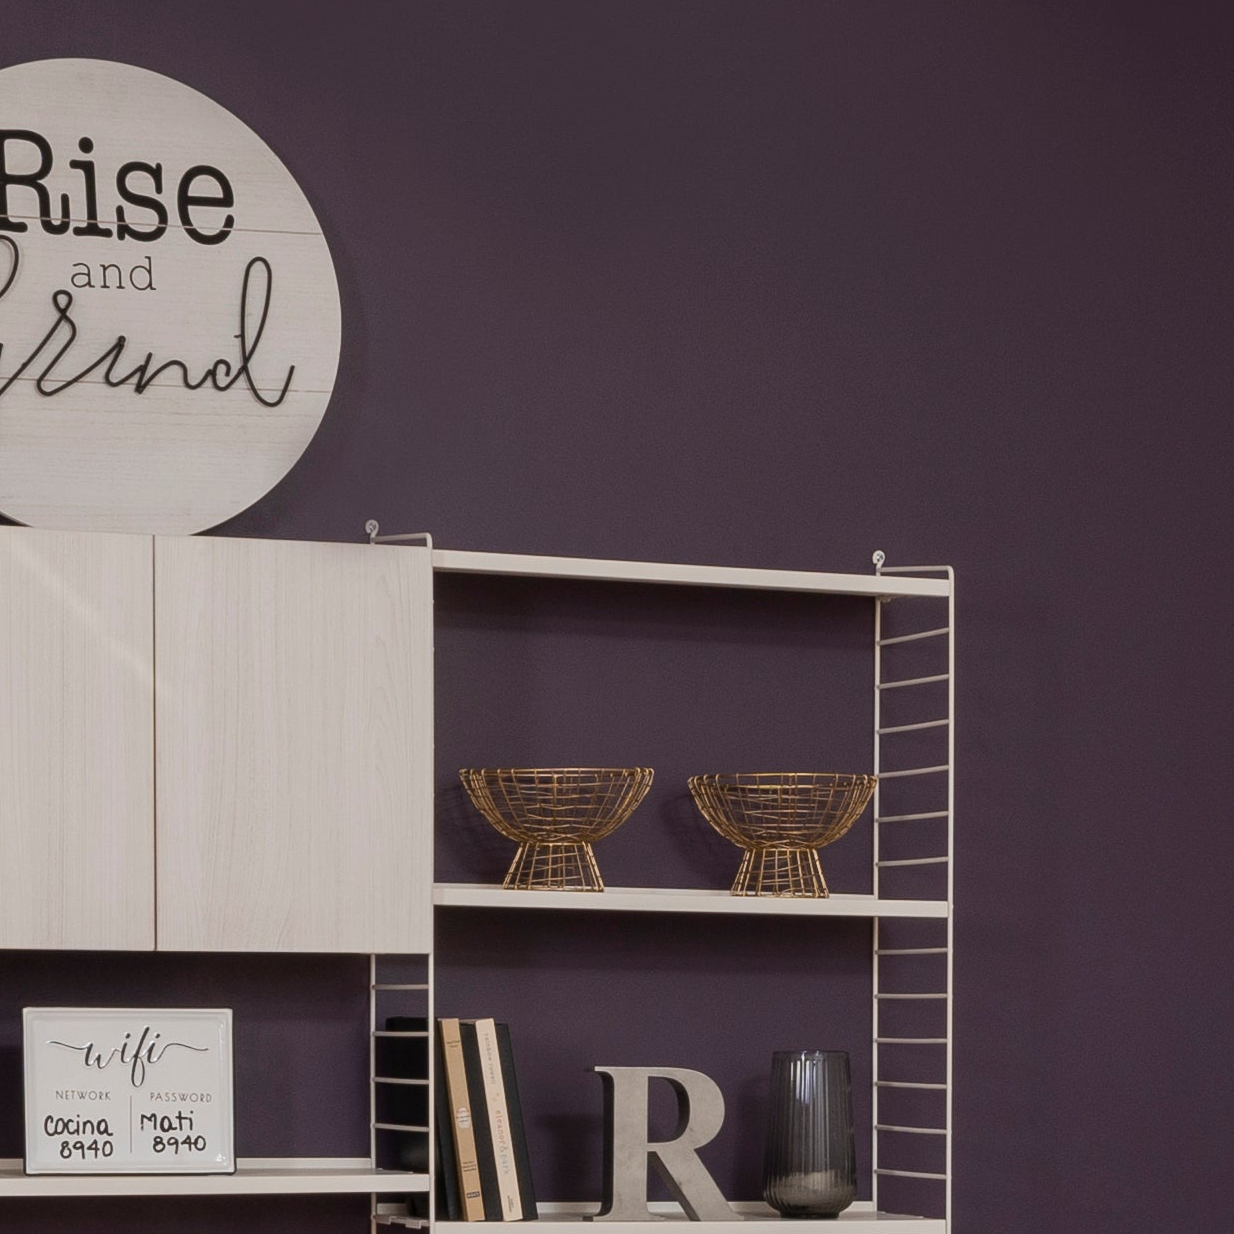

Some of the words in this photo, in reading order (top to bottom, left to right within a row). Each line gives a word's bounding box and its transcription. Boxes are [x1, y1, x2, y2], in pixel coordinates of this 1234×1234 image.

[70, 256, 157, 290] and
[47, 1025, 209, 1088] wifi
[55, 1090, 111, 1101] NETWORK
[150, 1092, 212, 1103] PASSWORD
[140, 1110, 194, 1133] Mati
[59, 1139, 114, 1159] 8940
[152, 1135, 207, 1155] 8940
[586, 1066, 745, 1221] R
